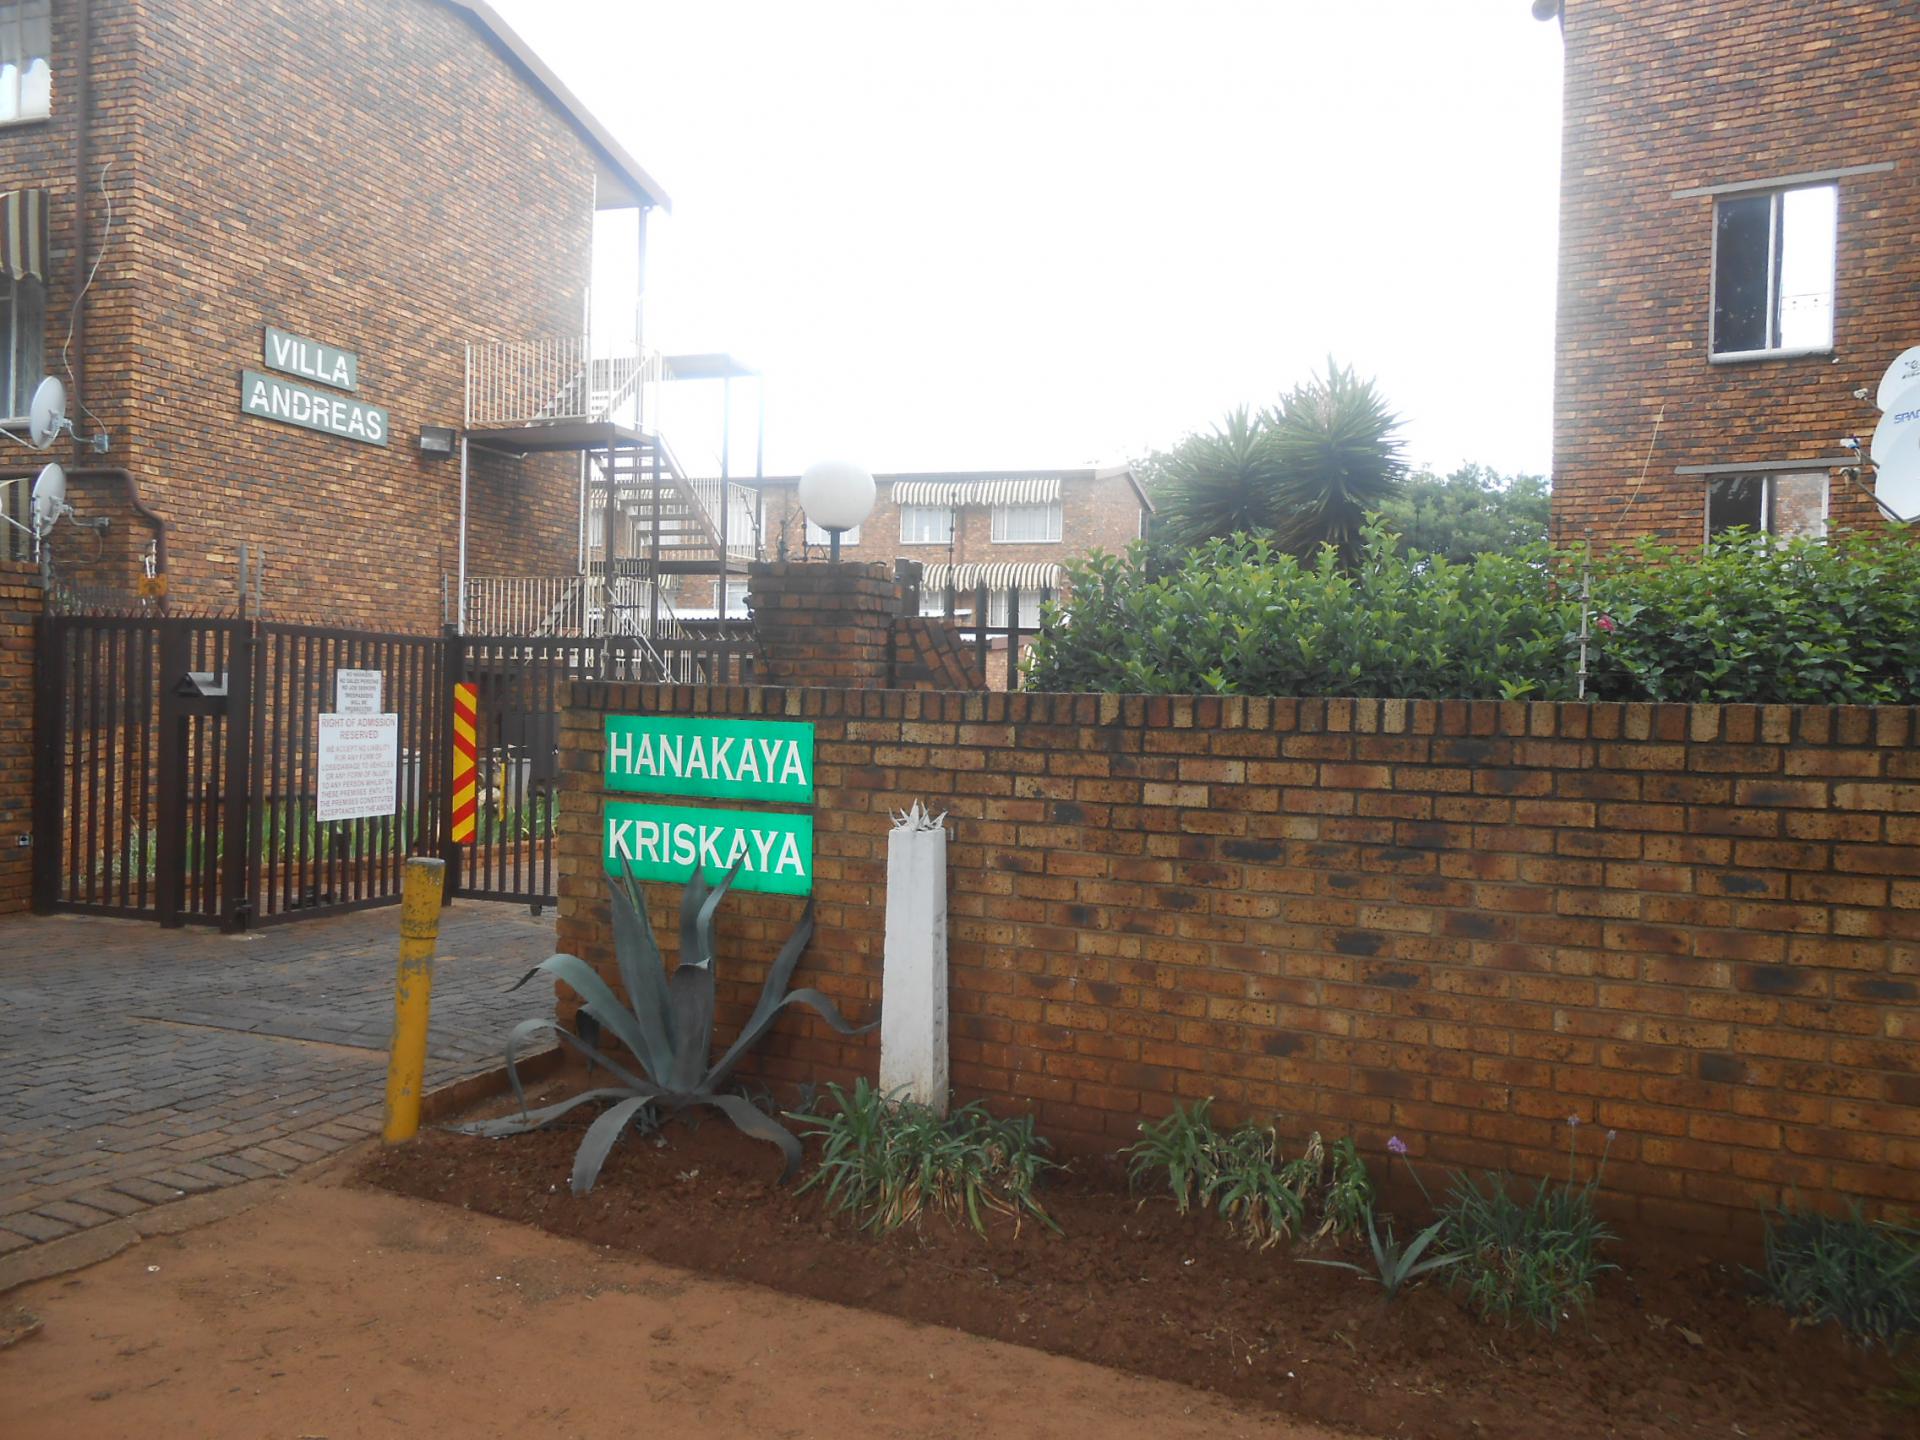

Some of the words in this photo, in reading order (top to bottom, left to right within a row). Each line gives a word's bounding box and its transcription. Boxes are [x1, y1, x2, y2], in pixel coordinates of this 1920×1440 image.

[272, 334, 350, 386] VILLA
[249, 380, 382, 440] ANDREAS
[322, 718, 343, 728] RIGHT
[346, 718, 356, 727] OF
[358, 718, 395, 727] ADMISSION
[340, 730, 379, 739] RESERVED
[610, 731, 808, 786] HANAKAYA
[608, 818, 806, 876] KRISKAYA
